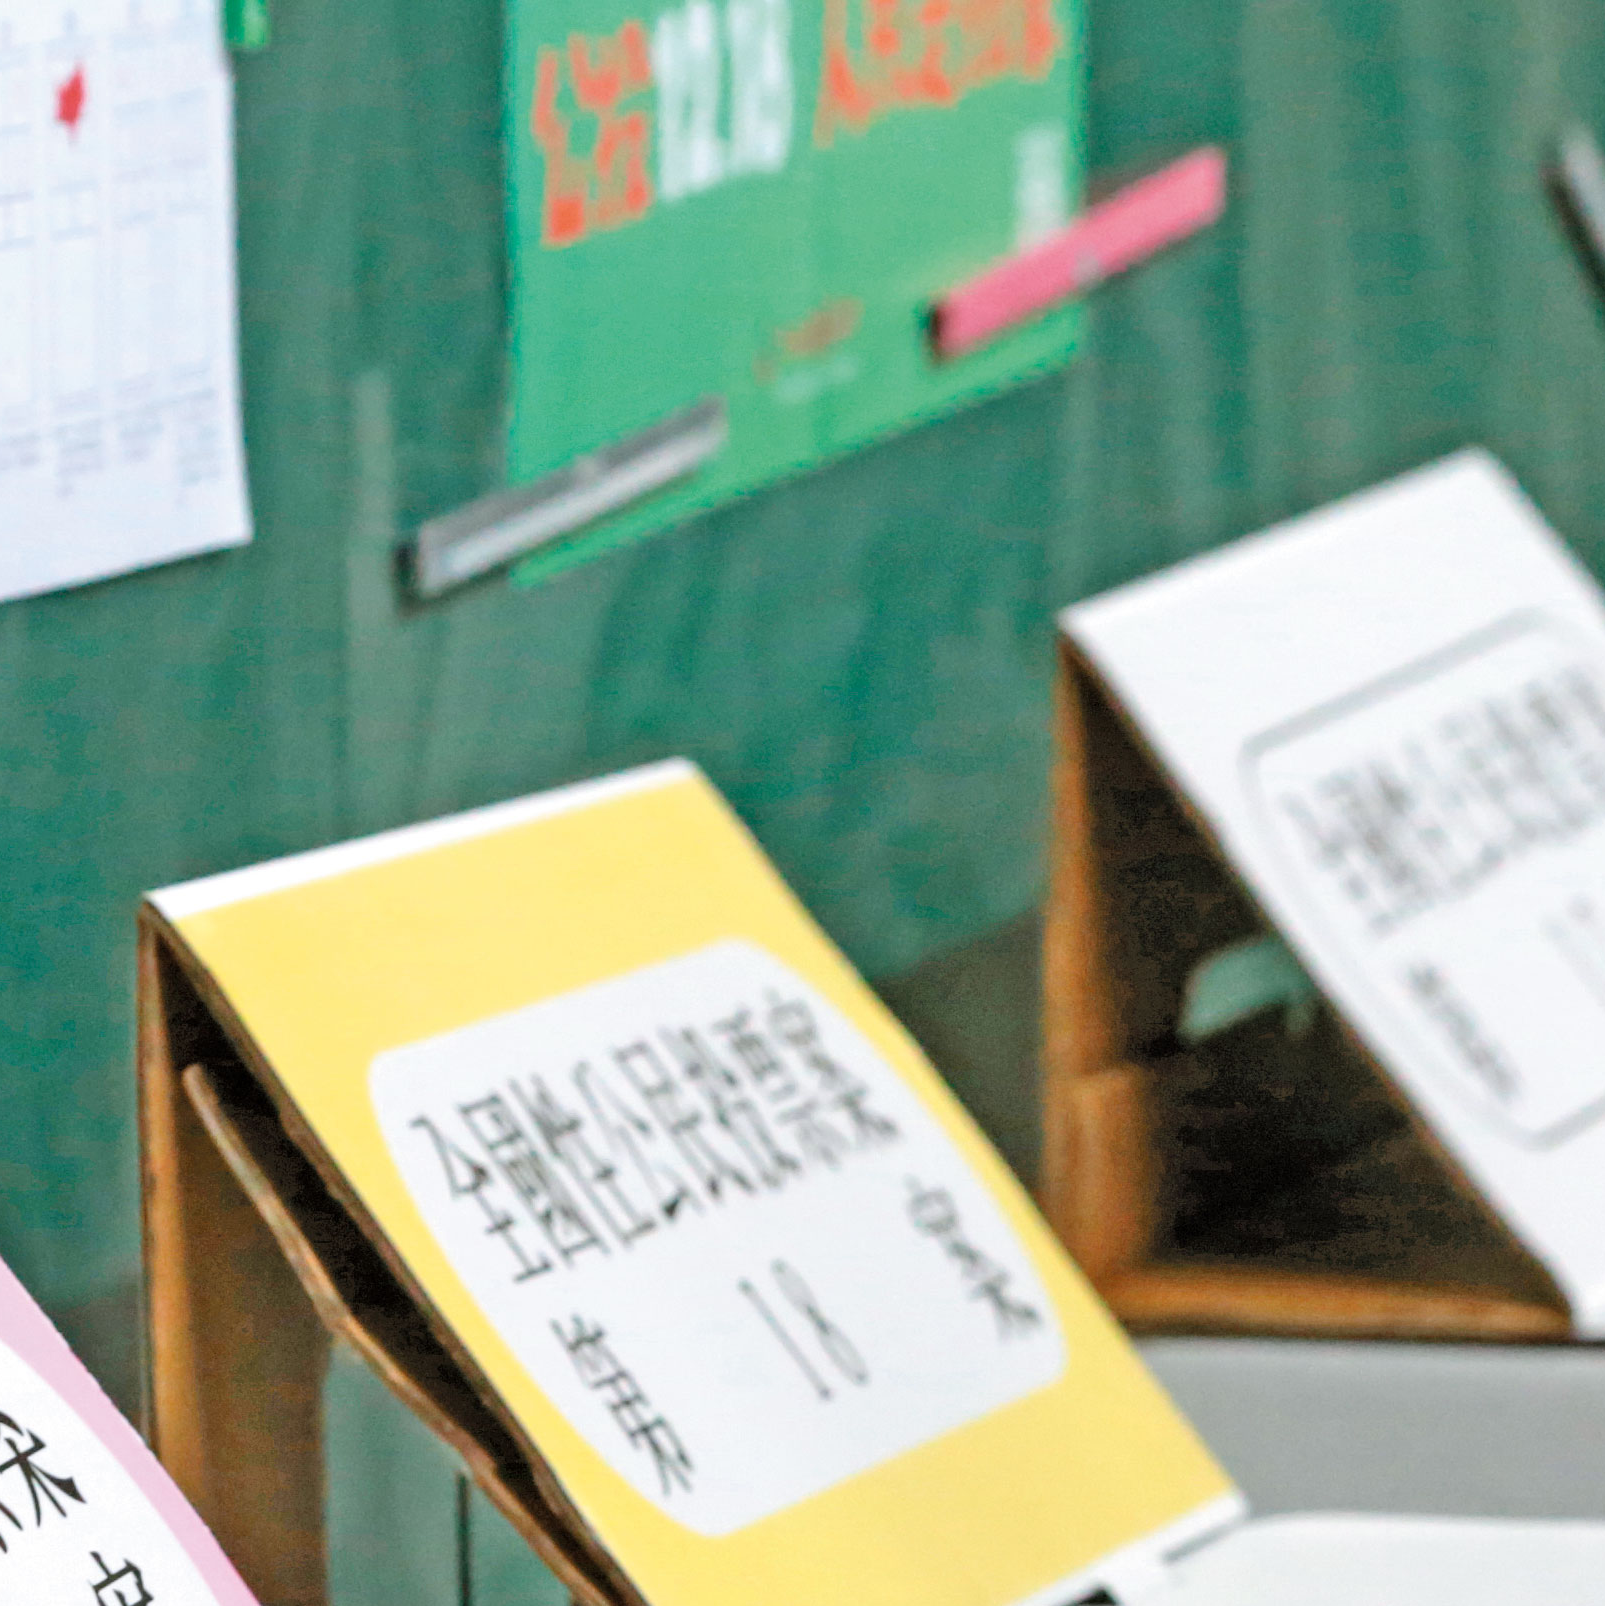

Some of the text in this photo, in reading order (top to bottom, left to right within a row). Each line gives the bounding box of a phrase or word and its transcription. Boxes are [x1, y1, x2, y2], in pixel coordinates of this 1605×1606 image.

[408, 986, 901, 1284] 全國性公民投票案
[549, 1172, 1043, 1498] 第 18 案
